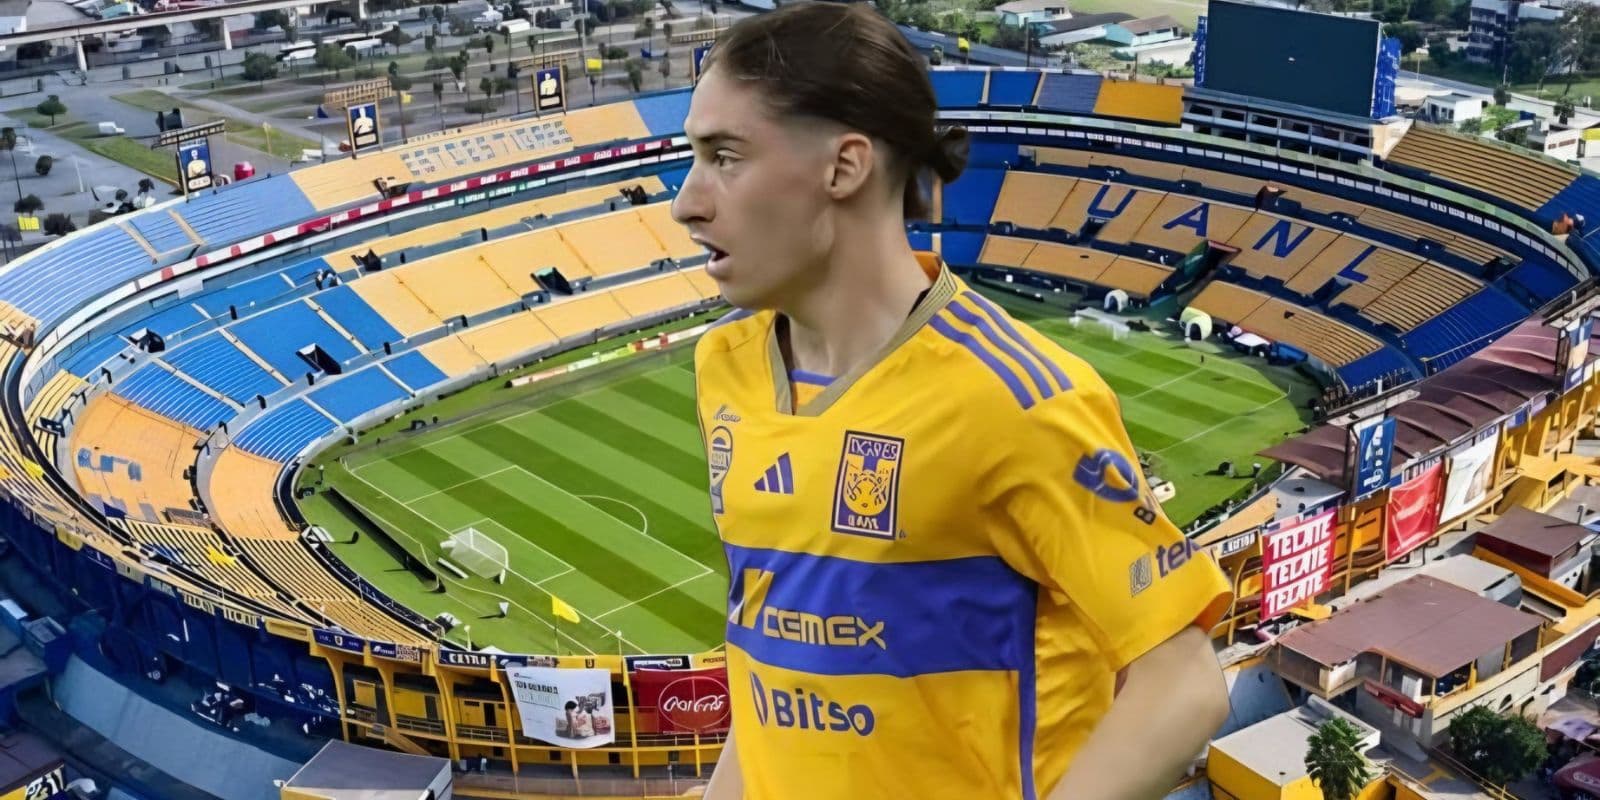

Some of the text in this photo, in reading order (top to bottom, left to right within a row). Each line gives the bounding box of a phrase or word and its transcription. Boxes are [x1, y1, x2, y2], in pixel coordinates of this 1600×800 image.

[1087, 184, 1377, 283] UANL
[1267, 511, 1336, 560] TECATE
[1265, 540, 1332, 588] TECATE
[1265, 565, 1329, 614] TECATE
[763, 605, 887, 650] CEMEX
[771, 687, 875, 736] Bitso
